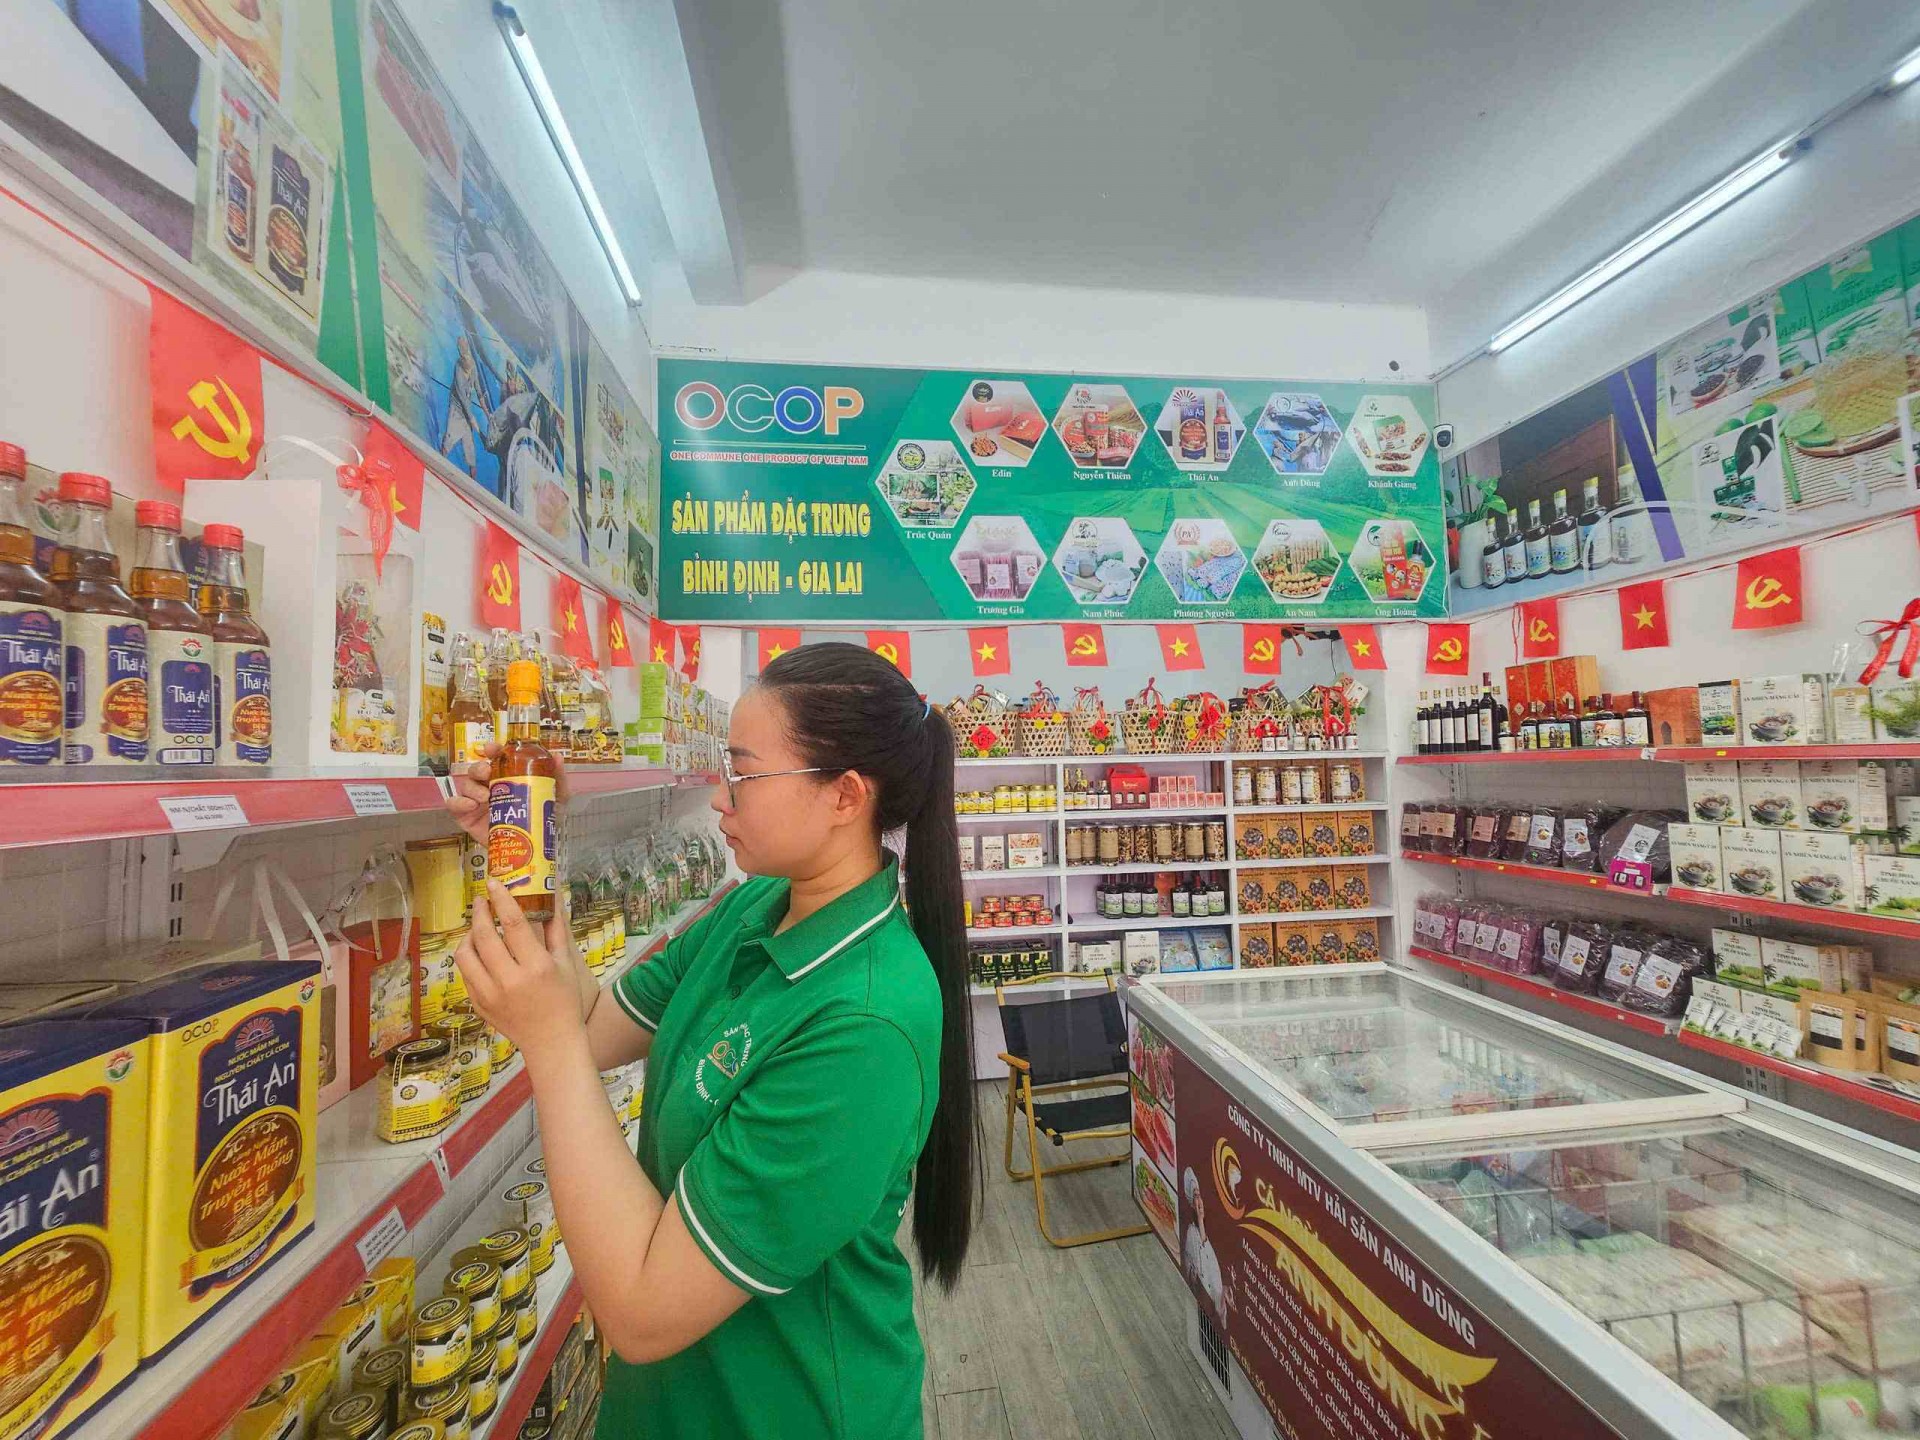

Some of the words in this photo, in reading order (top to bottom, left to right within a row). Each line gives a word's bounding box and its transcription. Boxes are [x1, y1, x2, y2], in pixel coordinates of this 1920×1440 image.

[674, 380, 865, 436] OCOP
[670, 451, 693, 460] ONE
[693, 452, 741, 462] COMMUNE
[742, 453, 764, 463] ONE
[764, 454, 808, 464] PRODUCT
[810, 455, 823, 464] OF
[824, 455, 846, 465] VIET
[847, 456, 869, 465] NAM
[672, 491, 708, 534] SẢN
[714, 489, 767, 534] PHẨM
[771, 496, 808, 544] ĐẶC
[811, 502, 871, 537] TRƯNG
[905, 531, 926, 540] Trúc
[683, 552, 728, 594] BÌNH
[733, 560, 780, 603] ĐỊNH
[798, 560, 831, 595] GIA
[835, 561, 863, 595] LAI
[1008, 606, 1025, 614] Gia
[1083, 610, 1102, 618] Nam
[0, 639, 40, 664] Thái
[110, 650, 138, 671] Thái
[167, 684, 196, 704] Thái
[197, 689, 210, 709] An
[237, 672, 261, 690] Thái
[489, 808, 501, 824] hái
[504, 806, 526, 825] An
[182, 1018, 219, 1043] OCOP
[203, 1078, 258, 1125] Thái
[263, 1062, 295, 1107] An
[200, 1177, 252, 1221] Truyền
[256, 1148, 294, 1182] Thống
[210, 1160, 251, 1194] Nước
[253, 1135, 288, 1166] Mắm
[0, 1194, 31, 1241] ái
[38, 1164, 100, 1230] An
[1255, 1177, 1276, 1211] CÁ
[1228, 1104, 1251, 1139] CÔNG
[1251, 1127, 1264, 1146] TY
[1266, 1138, 1294, 1177] TNHH
[1297, 1165, 1321, 1203] MTV
[1325, 1191, 1347, 1228] HẢI
[1350, 1214, 1379, 1259] SẢN
[1382, 1246, 1417, 1295] ANH
[1421, 1279, 1476, 1350] DŨNG
[20, 1264, 88, 1317] Mắm
[26, 1279, 99, 1337] Thống
[1276, 1245, 1334, 1332] ANH
[1242, 1238, 1261, 1269] Mang
[1268, 1269, 1285, 1298] biển
[1285, 1288, 1303, 1318] khơi
[1303, 1316, 1335, 1357] nguyên
[1356, 1376, 1375, 1407] đến
[1377, 1401, 1398, 1437] bàn
[1275, 1299, 1298, 1337] lượng
[1299, 1332, 1320, 1364] xanh
[1245, 1306, 1260, 1331] Giao
[1260, 1326, 1279, 1359] hàng
[1279, 1354, 1294, 1381] 24h
[1295, 1375, 1314, 1408] toàn
[1315, 1404, 1336, 1437] quốc
